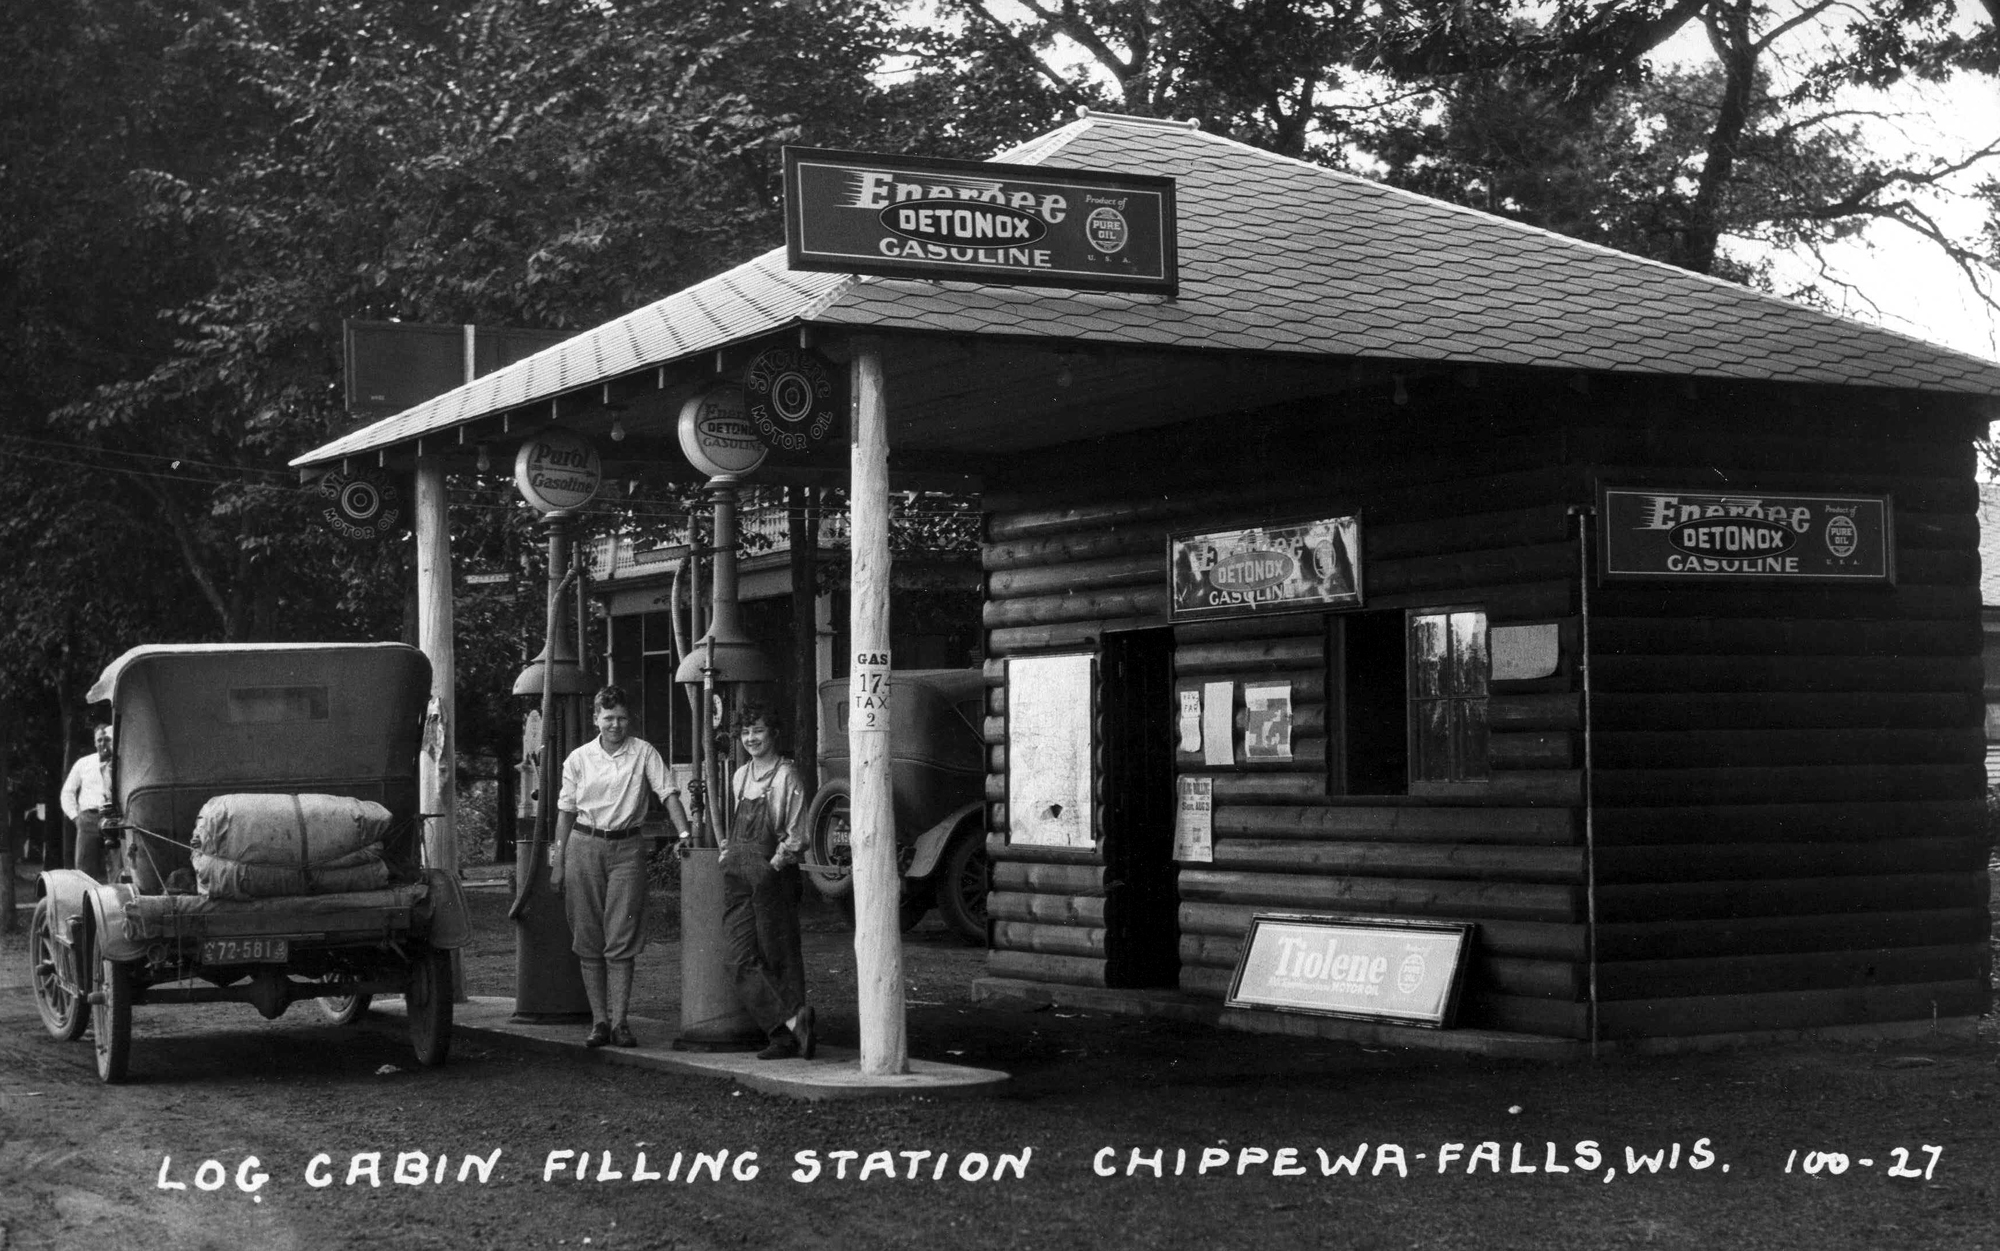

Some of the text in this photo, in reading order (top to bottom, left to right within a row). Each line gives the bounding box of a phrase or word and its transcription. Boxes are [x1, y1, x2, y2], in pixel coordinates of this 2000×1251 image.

[1085, 194, 1128, 211] Product of
[899, 208, 1030, 239] DETONOX
[1092, 220, 1121, 231] PURE
[1098, 230, 1117, 240] OIL
[879, 238, 1052, 268] GASOLINE
[708, 422, 755, 437] DETON
[751, 404, 833, 450] MOTOR OIL
[532, 473, 592, 493] Gasoline
[322, 507, 399, 540] MOTOR OIL
[1831, 527, 1853, 536] PURE
[1683, 526, 1783, 551] DETONOX
[1834, 536, 1849, 544] OIL
[1217, 558, 1285, 584] DETONOX
[1667, 554, 1799, 573] GASOLINE
[857, 653, 888, 666] GAS
[856, 696, 888, 710] TAX
[865, 712, 876, 727] 2
[1274, 936, 1388, 985] Tiolene
